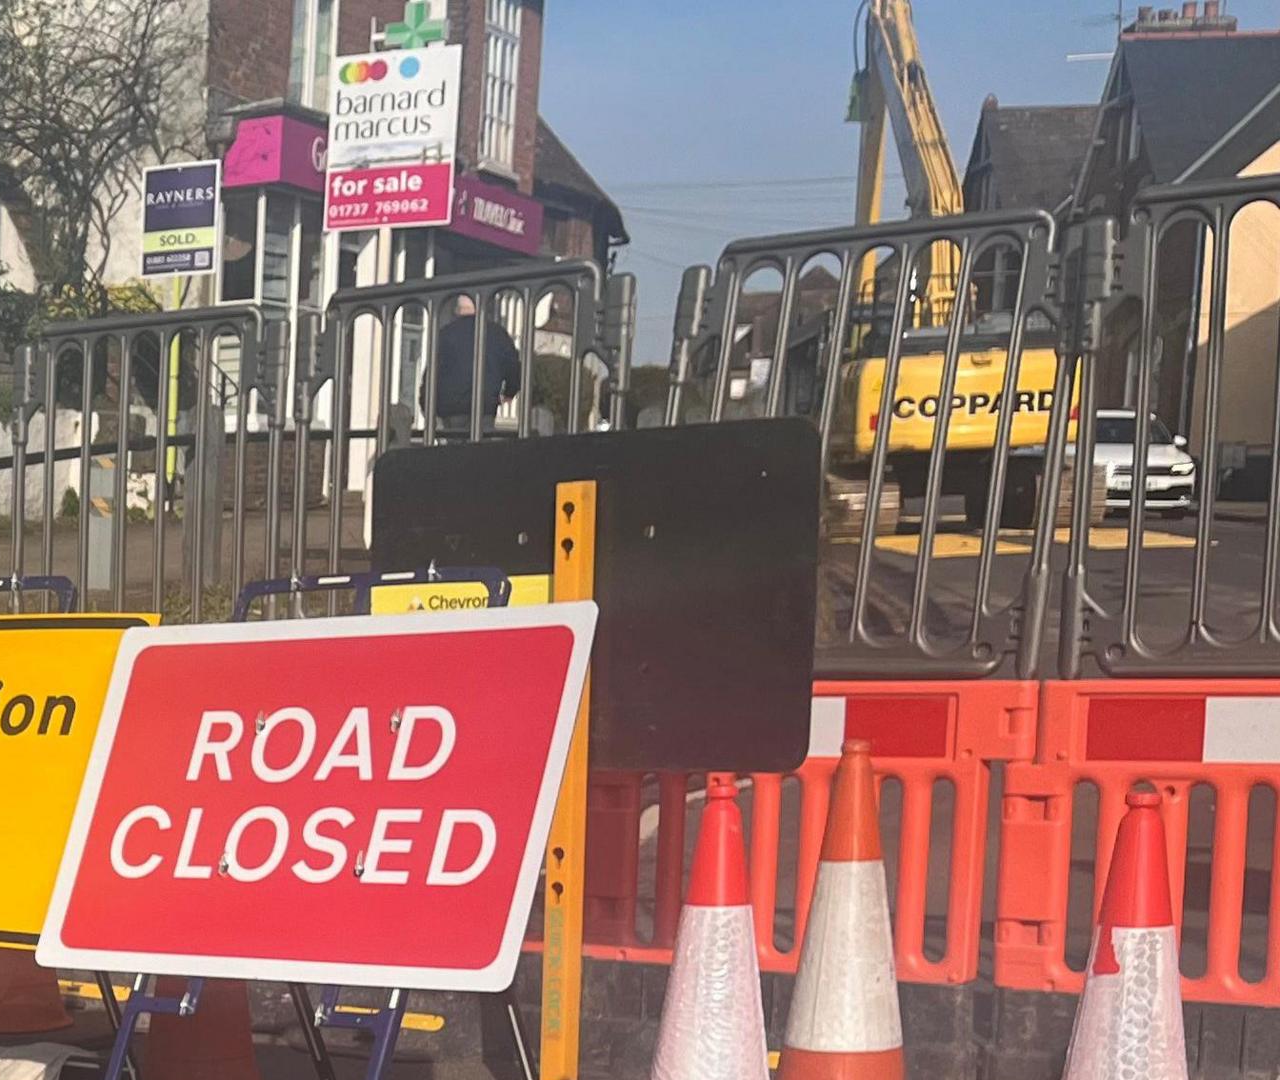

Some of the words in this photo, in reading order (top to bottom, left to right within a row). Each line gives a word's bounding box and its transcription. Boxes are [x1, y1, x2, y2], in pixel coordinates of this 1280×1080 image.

[336, 80, 446, 116] barnard
[334, 115, 432, 141] marcus
[146, 186, 214, 206] RAYNERS
[331, 175, 368, 198] for
[373, 170, 423, 194] sale
[329, 202, 369, 218] 01737
[893, 391, 1055, 419] COPPARD
[185, 705, 457, 784] ROAD
[109, 804, 498, 886] CLOSED
